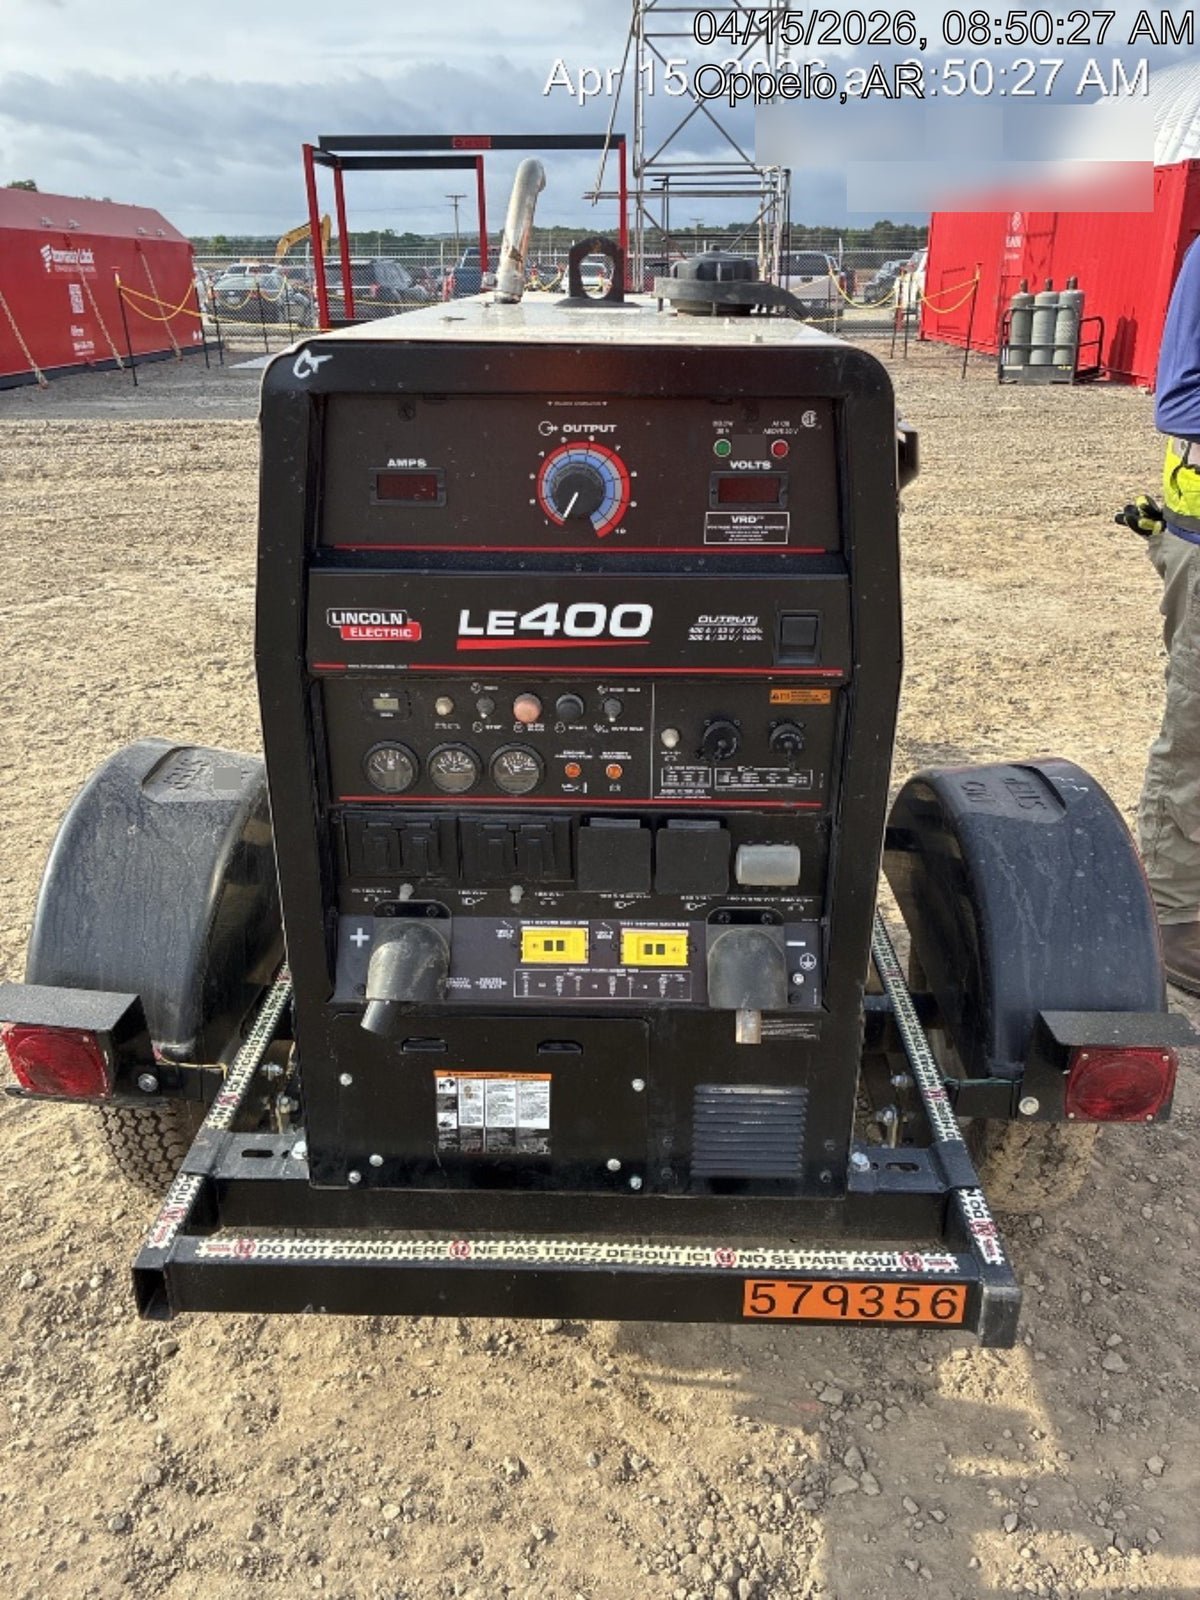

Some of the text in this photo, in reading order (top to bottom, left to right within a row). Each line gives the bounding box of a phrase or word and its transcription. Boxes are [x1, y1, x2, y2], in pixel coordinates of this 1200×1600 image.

[562, 424, 618, 433] OUTPUT
[387, 458, 428, 468] AMPS
[730, 460, 773, 470] VOLTS
[331, 612, 404, 625] LINCOLN
[457, 602, 653, 637] LE400
[349, 627, 413, 638] ELECTRIC
[257, 1243, 448, 1256] DO NOT STAND HERE
[474, 1245, 711, 1262] NE PAS TENEZ DEBOUT ICI
[739, 1254, 767, 1265] NO
[771, 1254, 796, 1266] SE
[799, 1255, 849, 1267] PARE
[749, 1282, 958, 1320] 579356
